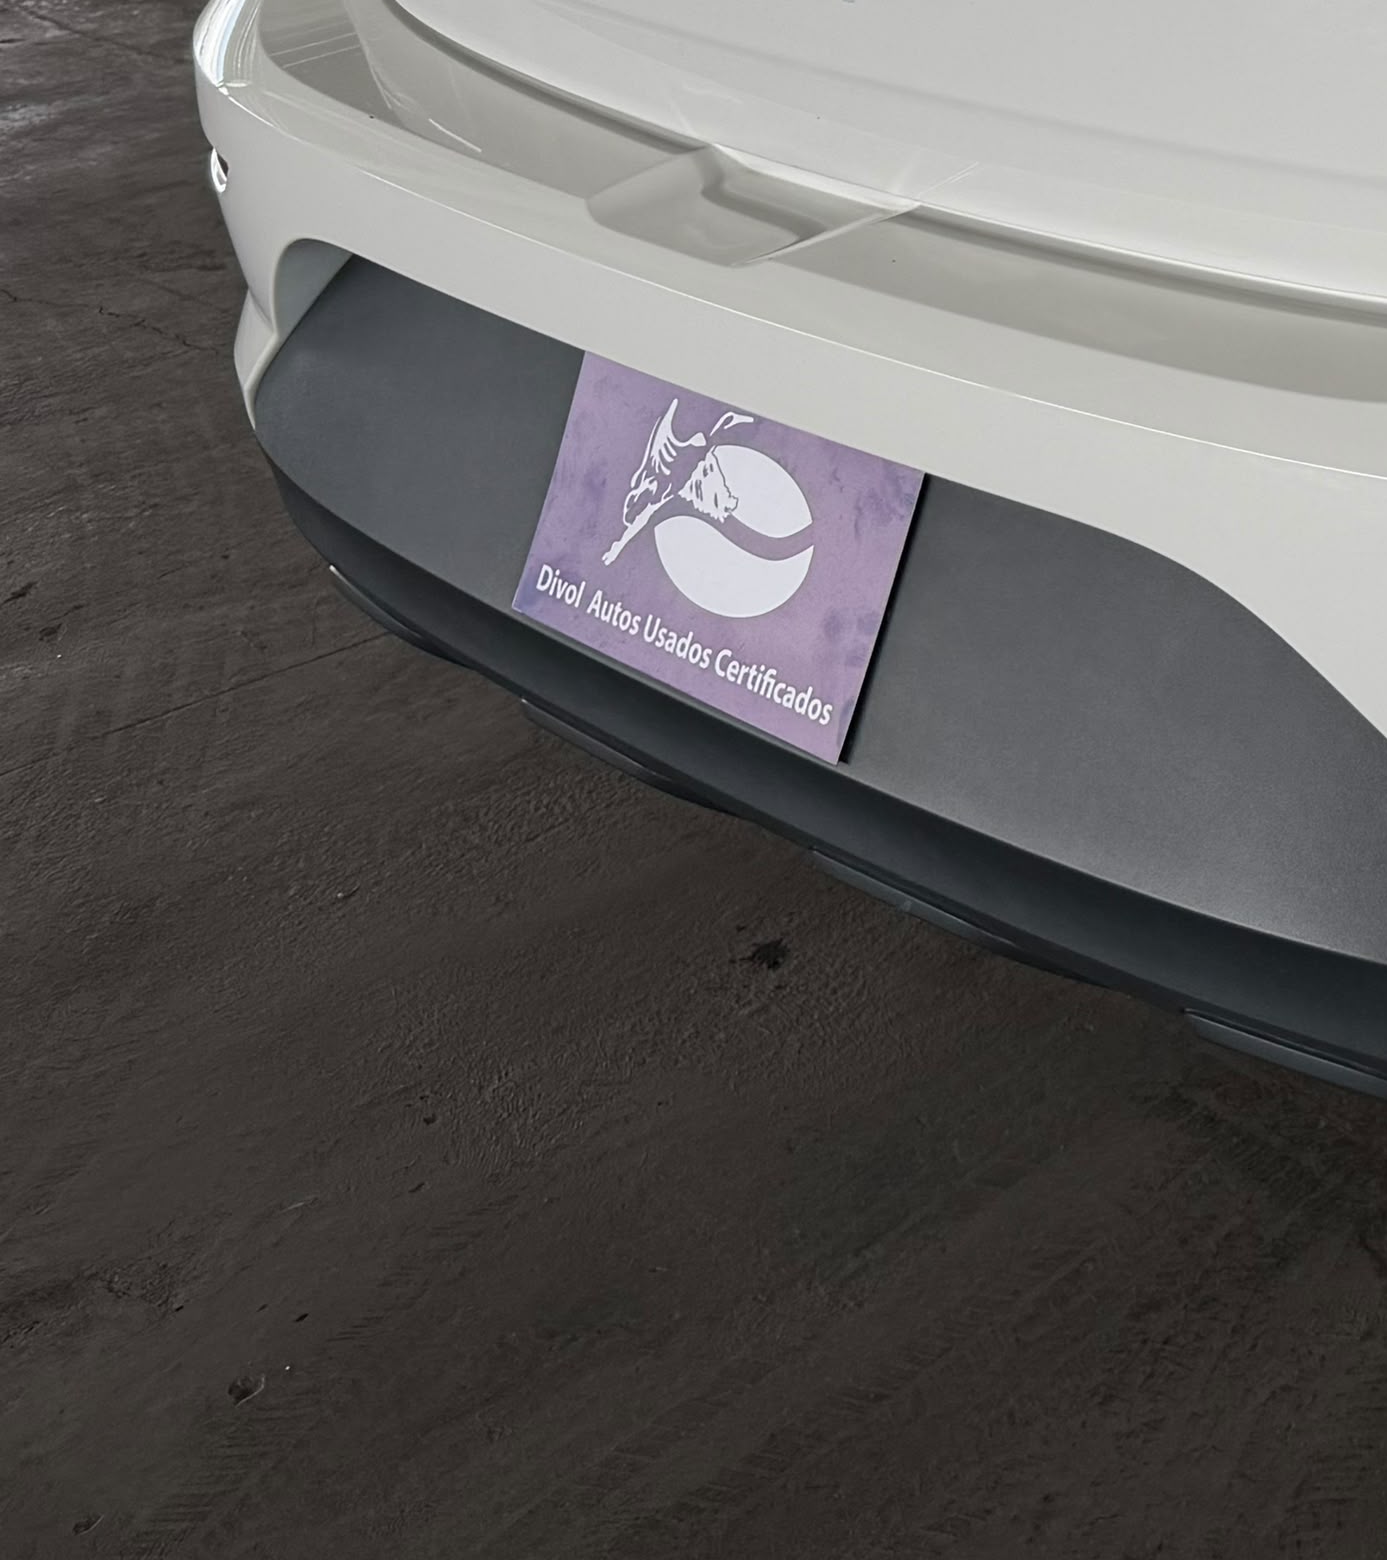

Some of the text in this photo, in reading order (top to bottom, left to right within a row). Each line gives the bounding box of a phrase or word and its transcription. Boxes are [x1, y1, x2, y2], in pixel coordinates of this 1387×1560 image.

[536, 564, 834, 726] Divol Autos Usados Certificados
